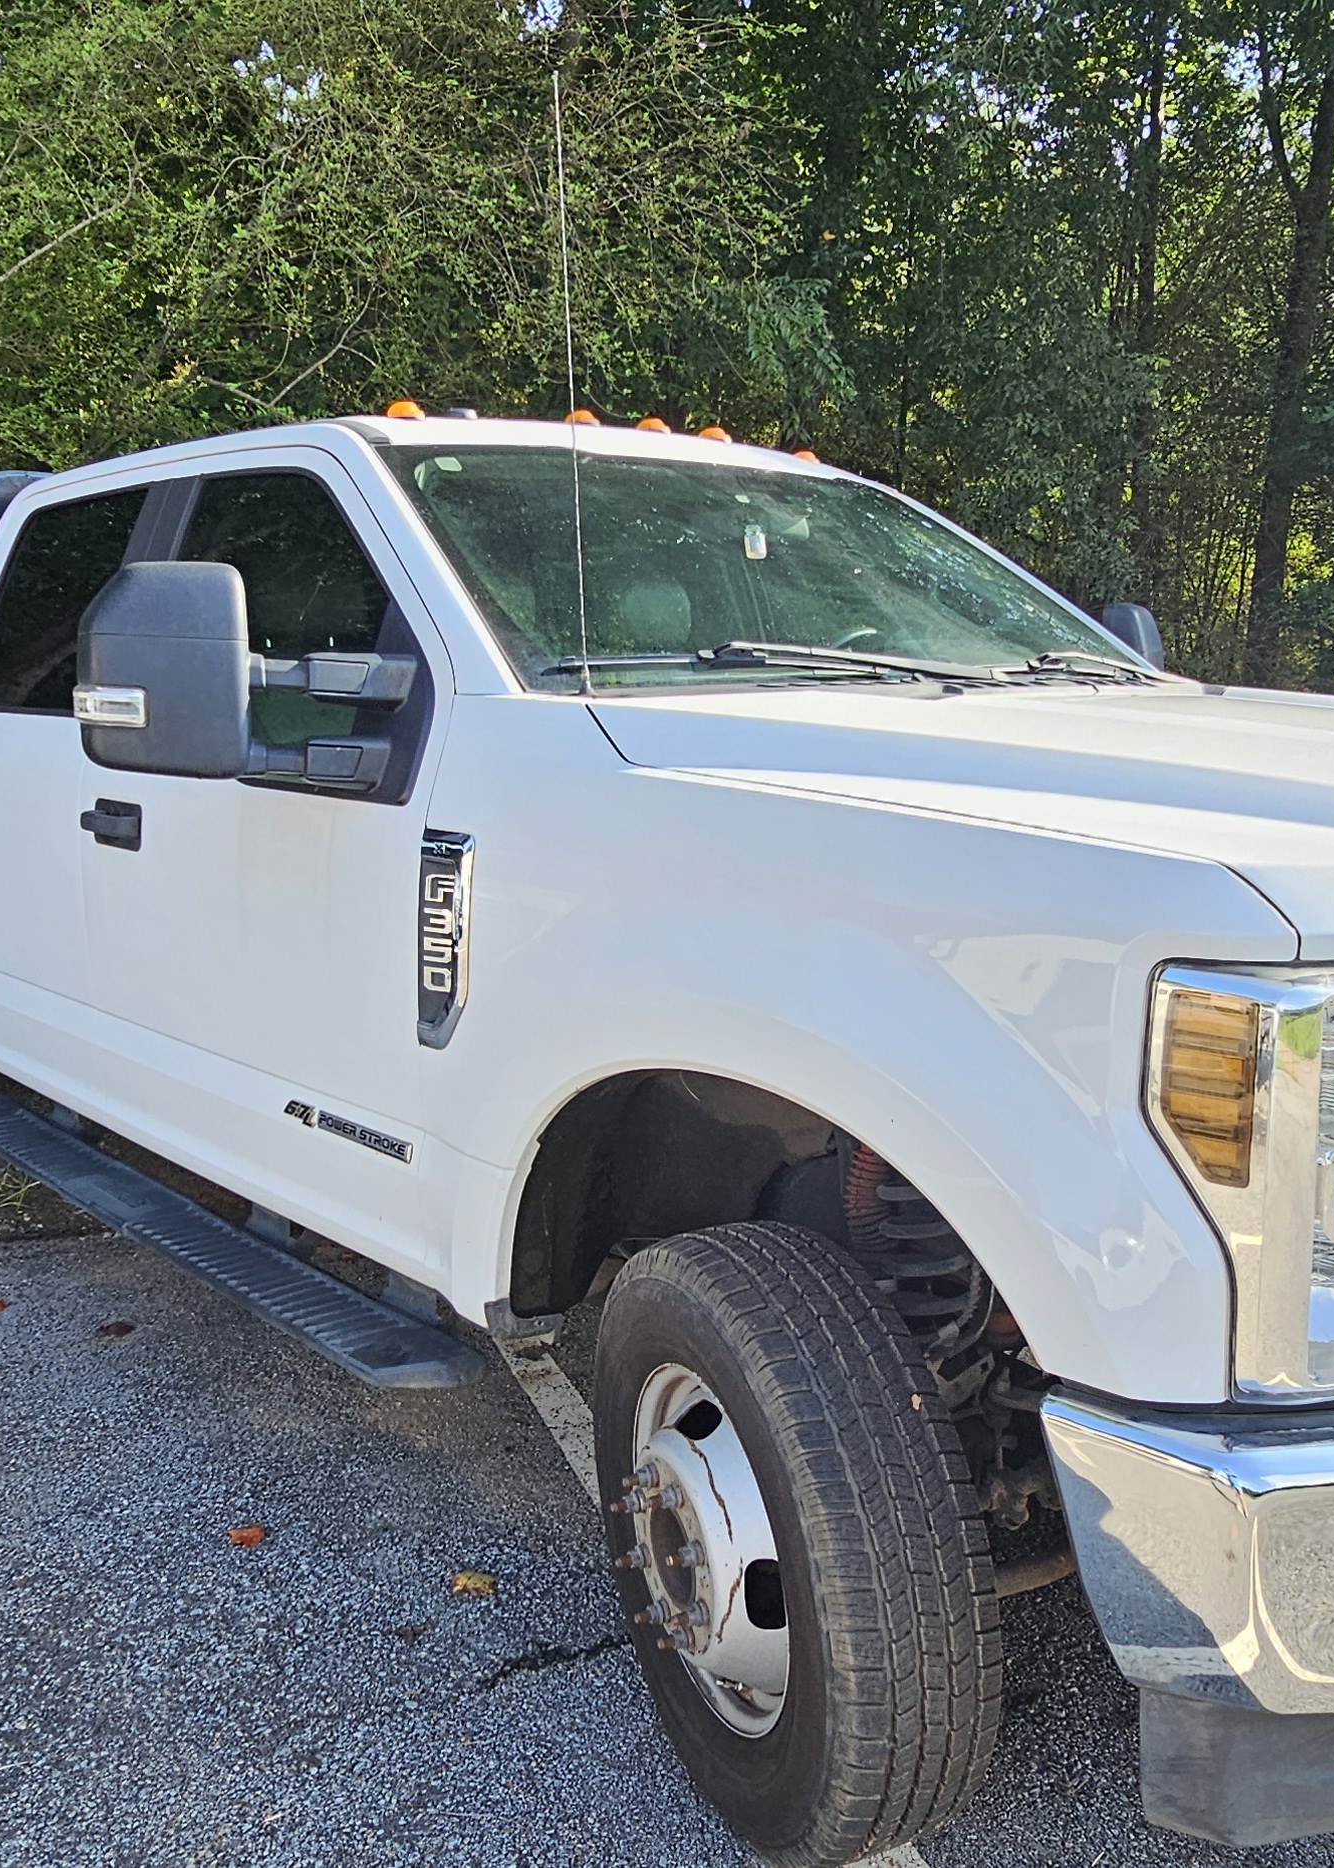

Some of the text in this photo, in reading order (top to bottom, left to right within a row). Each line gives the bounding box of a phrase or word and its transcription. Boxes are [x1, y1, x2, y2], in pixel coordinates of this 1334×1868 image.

[432, 842, 450, 856] XL
[423, 874, 456, 993] F350
[284, 1099, 406, 1156] 6.7L POWER STROKE
